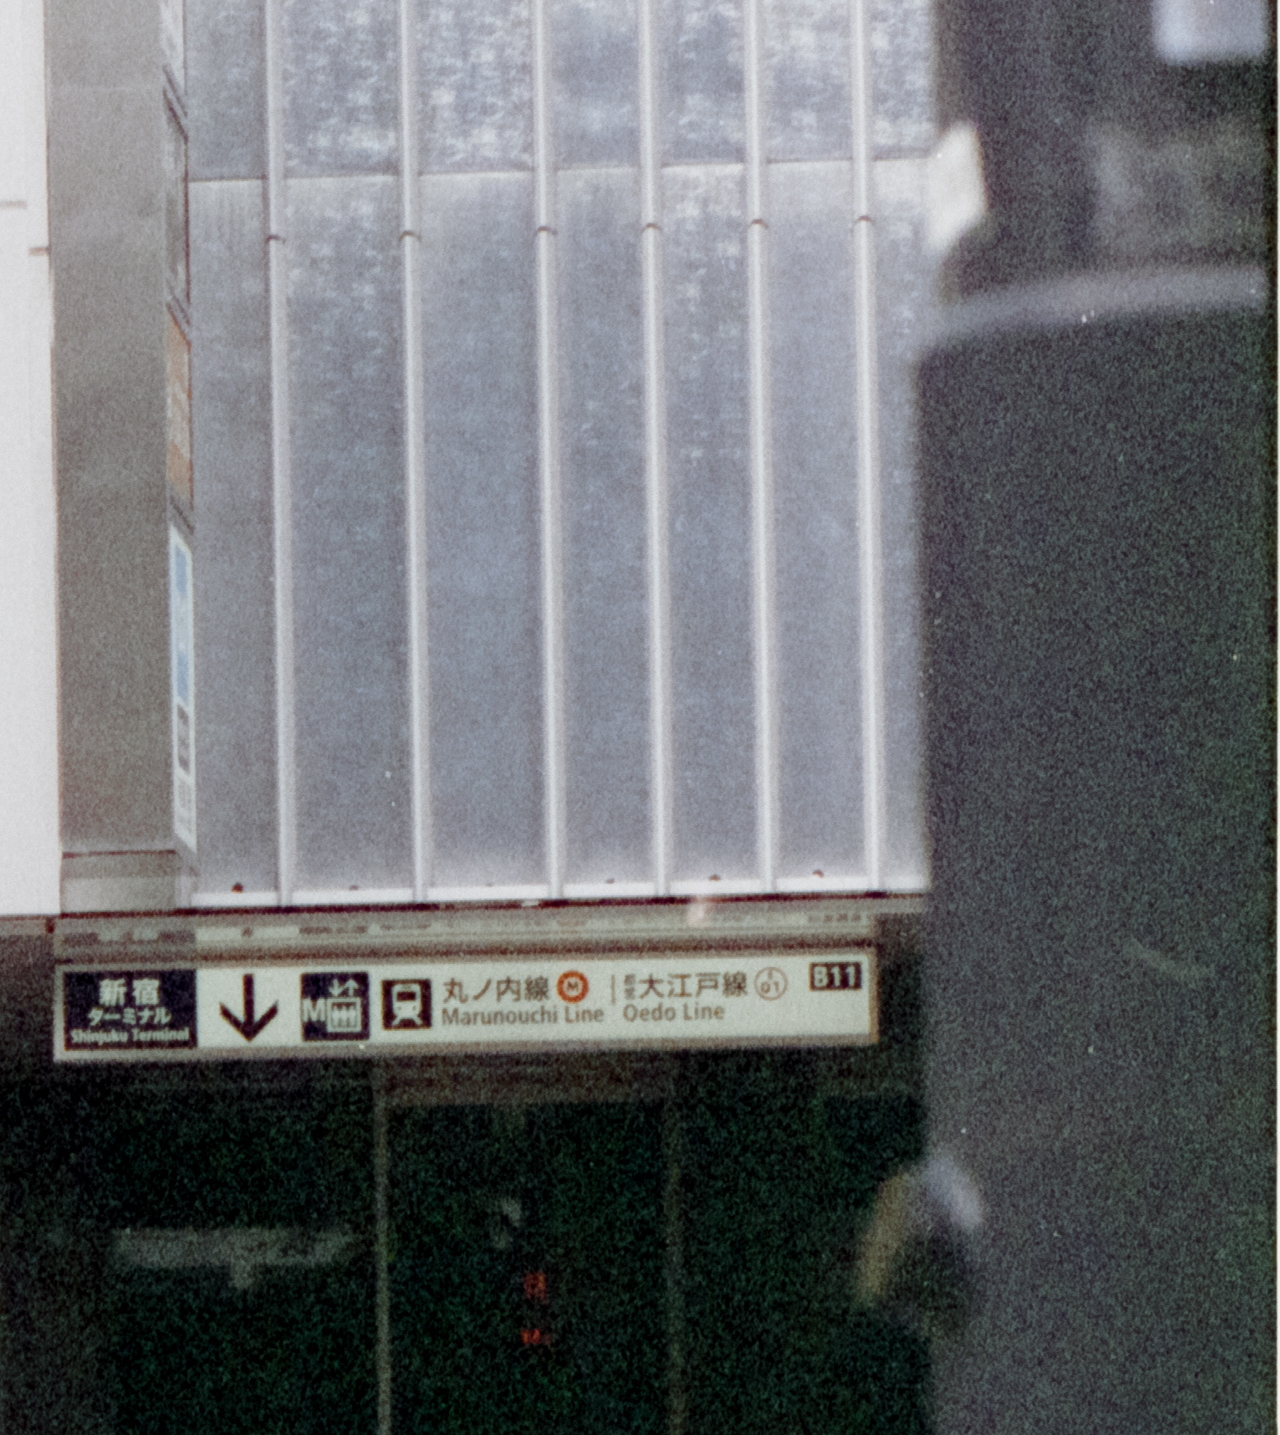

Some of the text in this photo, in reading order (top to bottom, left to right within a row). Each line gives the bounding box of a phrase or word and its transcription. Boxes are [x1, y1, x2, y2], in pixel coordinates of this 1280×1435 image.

[638, 972, 748, 1000] 大江戸線
[812, 965, 858, 989] B11
[99, 978, 160, 1006] 新宿
[443, 975, 550, 1003] 丸ノ内線
[88, 1007, 172, 1026] ターミナル
[442, 1004, 605, 1026] Marunouchi Line
[622, 1002, 726, 1023] Oedo Line
[70, 1026, 190, 1046] Shinjuku Terminal
